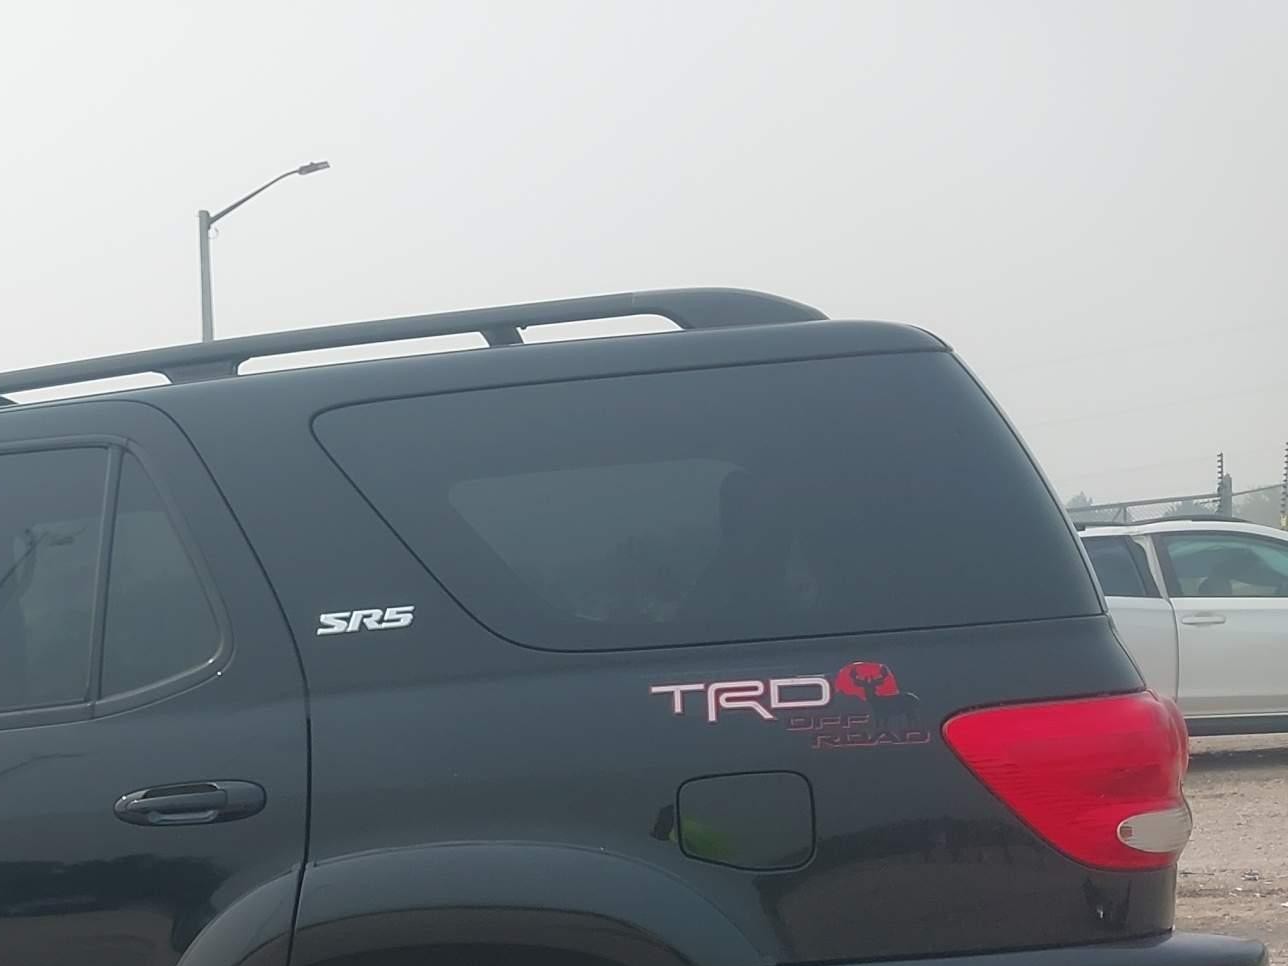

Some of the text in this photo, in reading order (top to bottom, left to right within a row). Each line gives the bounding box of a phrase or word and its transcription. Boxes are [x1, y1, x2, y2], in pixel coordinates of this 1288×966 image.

[316, 605, 415, 636] SR5
[650, 676, 832, 723] TRD
[785, 711, 872, 731] OFF
[811, 730, 932, 750] ROAD
